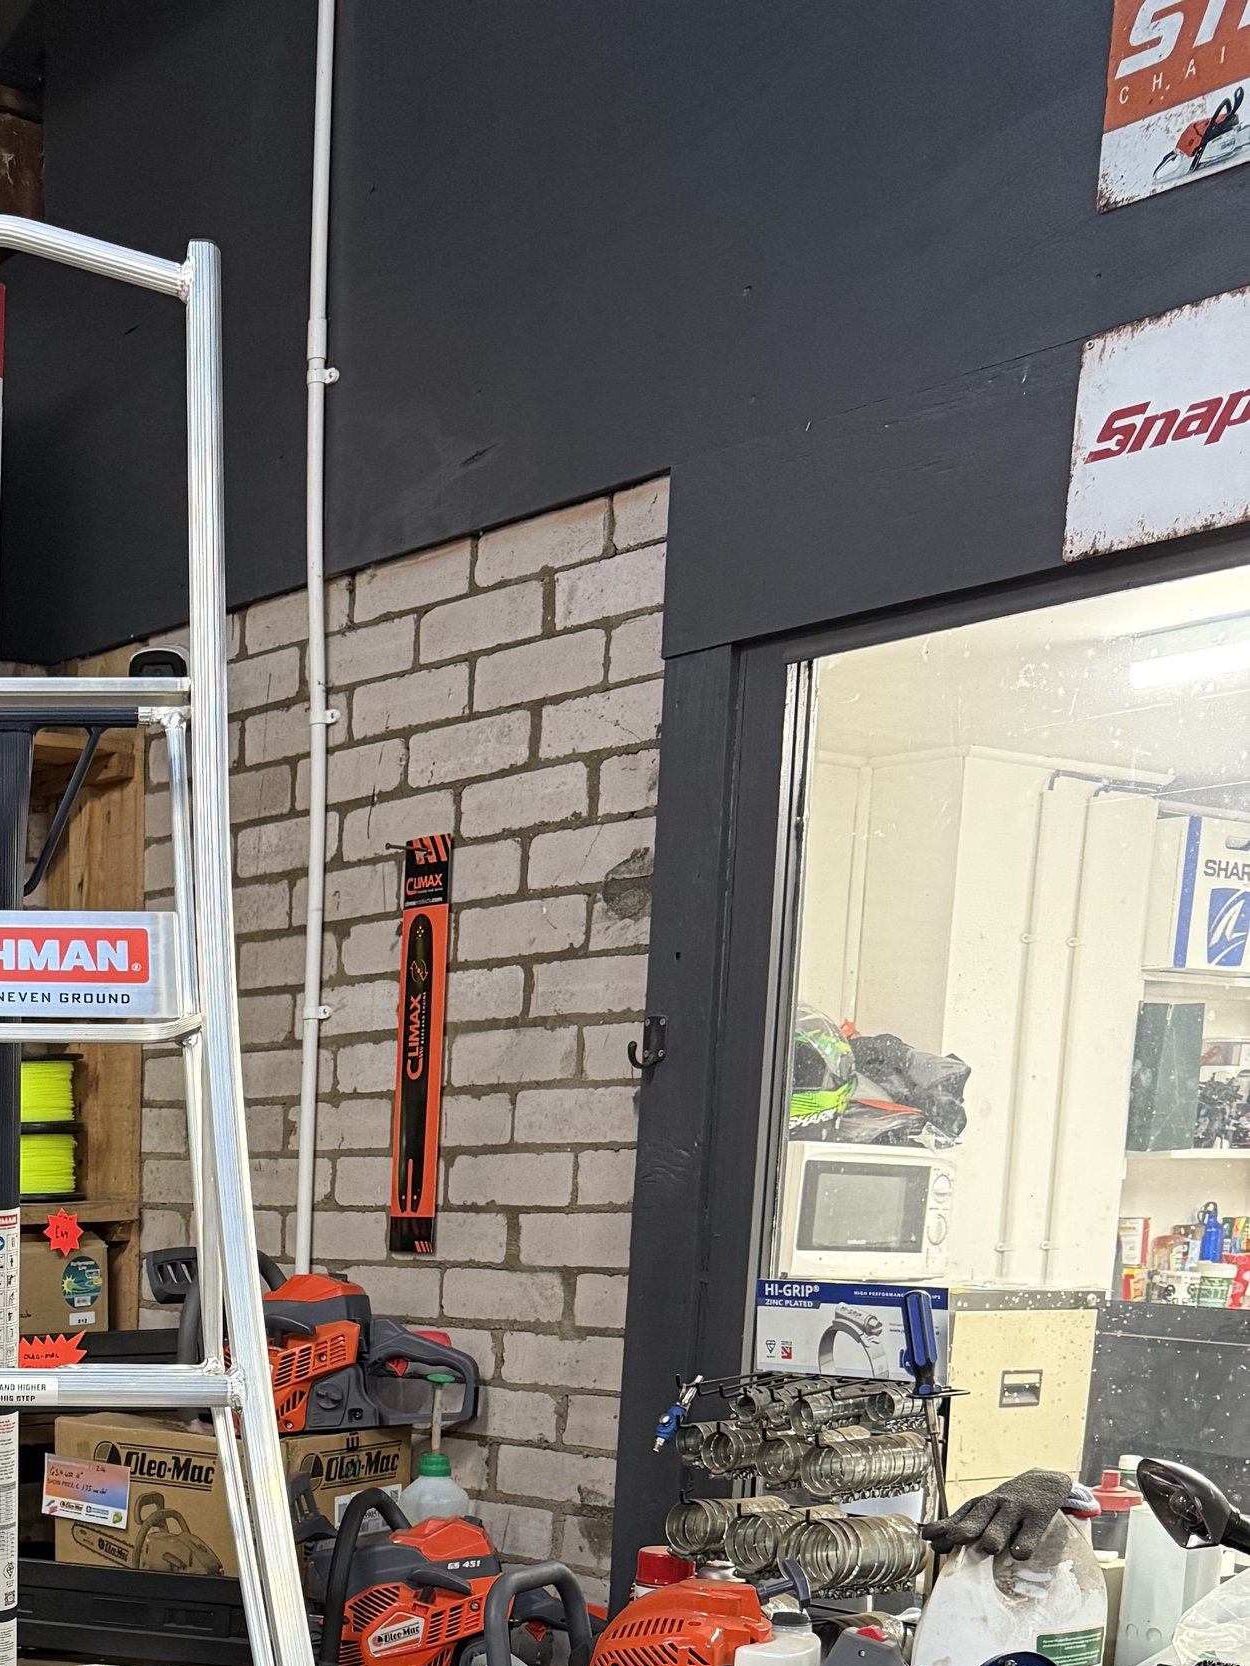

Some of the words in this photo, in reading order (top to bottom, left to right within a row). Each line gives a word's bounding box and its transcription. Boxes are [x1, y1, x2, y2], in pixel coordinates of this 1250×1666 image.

[406, 873, 443, 896] CLIMAX
[59, 992, 131, 1004] GROUND
[406, 993, 423, 1080] CLIMAX
[765, 1299, 784, 1307] ZINC
[17, 1383, 47, 1391] HIGHER
[447, 1561, 460, 1570] GS
[462, 1560, 481, 1568] 451
[384, 1626, 420, 1643] Oleo-Mac
